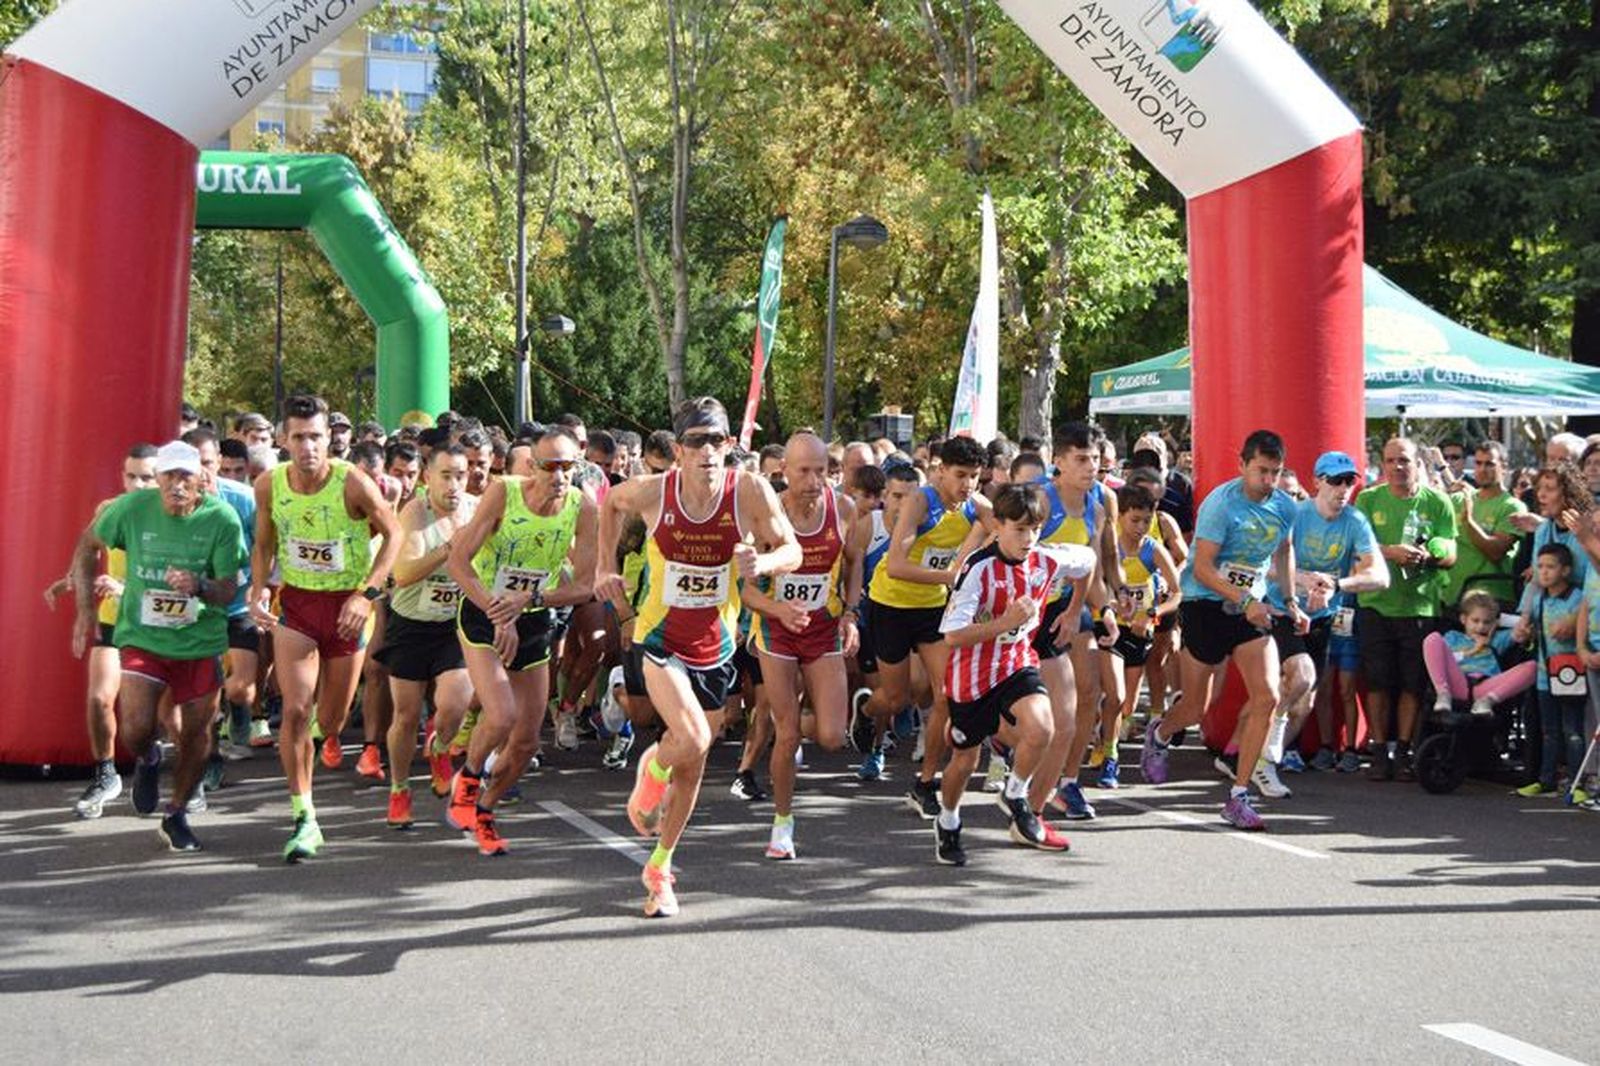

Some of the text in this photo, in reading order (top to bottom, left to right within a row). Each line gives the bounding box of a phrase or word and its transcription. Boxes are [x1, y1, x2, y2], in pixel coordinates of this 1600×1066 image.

[222, 0, 319, 79] AYUNTAM
[231, 0, 355, 98] DE ZAMO
[1079, 1, 1207, 129] AYUNTAMIENTO
[1059, 13, 1184, 147] DE ZAMORA
[298, 545, 333, 562] 376
[505, 576, 540, 592] 211
[676, 574, 719, 592] 454
[1227, 570, 1256, 588] 554
[783, 582, 822, 602] 887
[153, 598, 188, 613] 377
